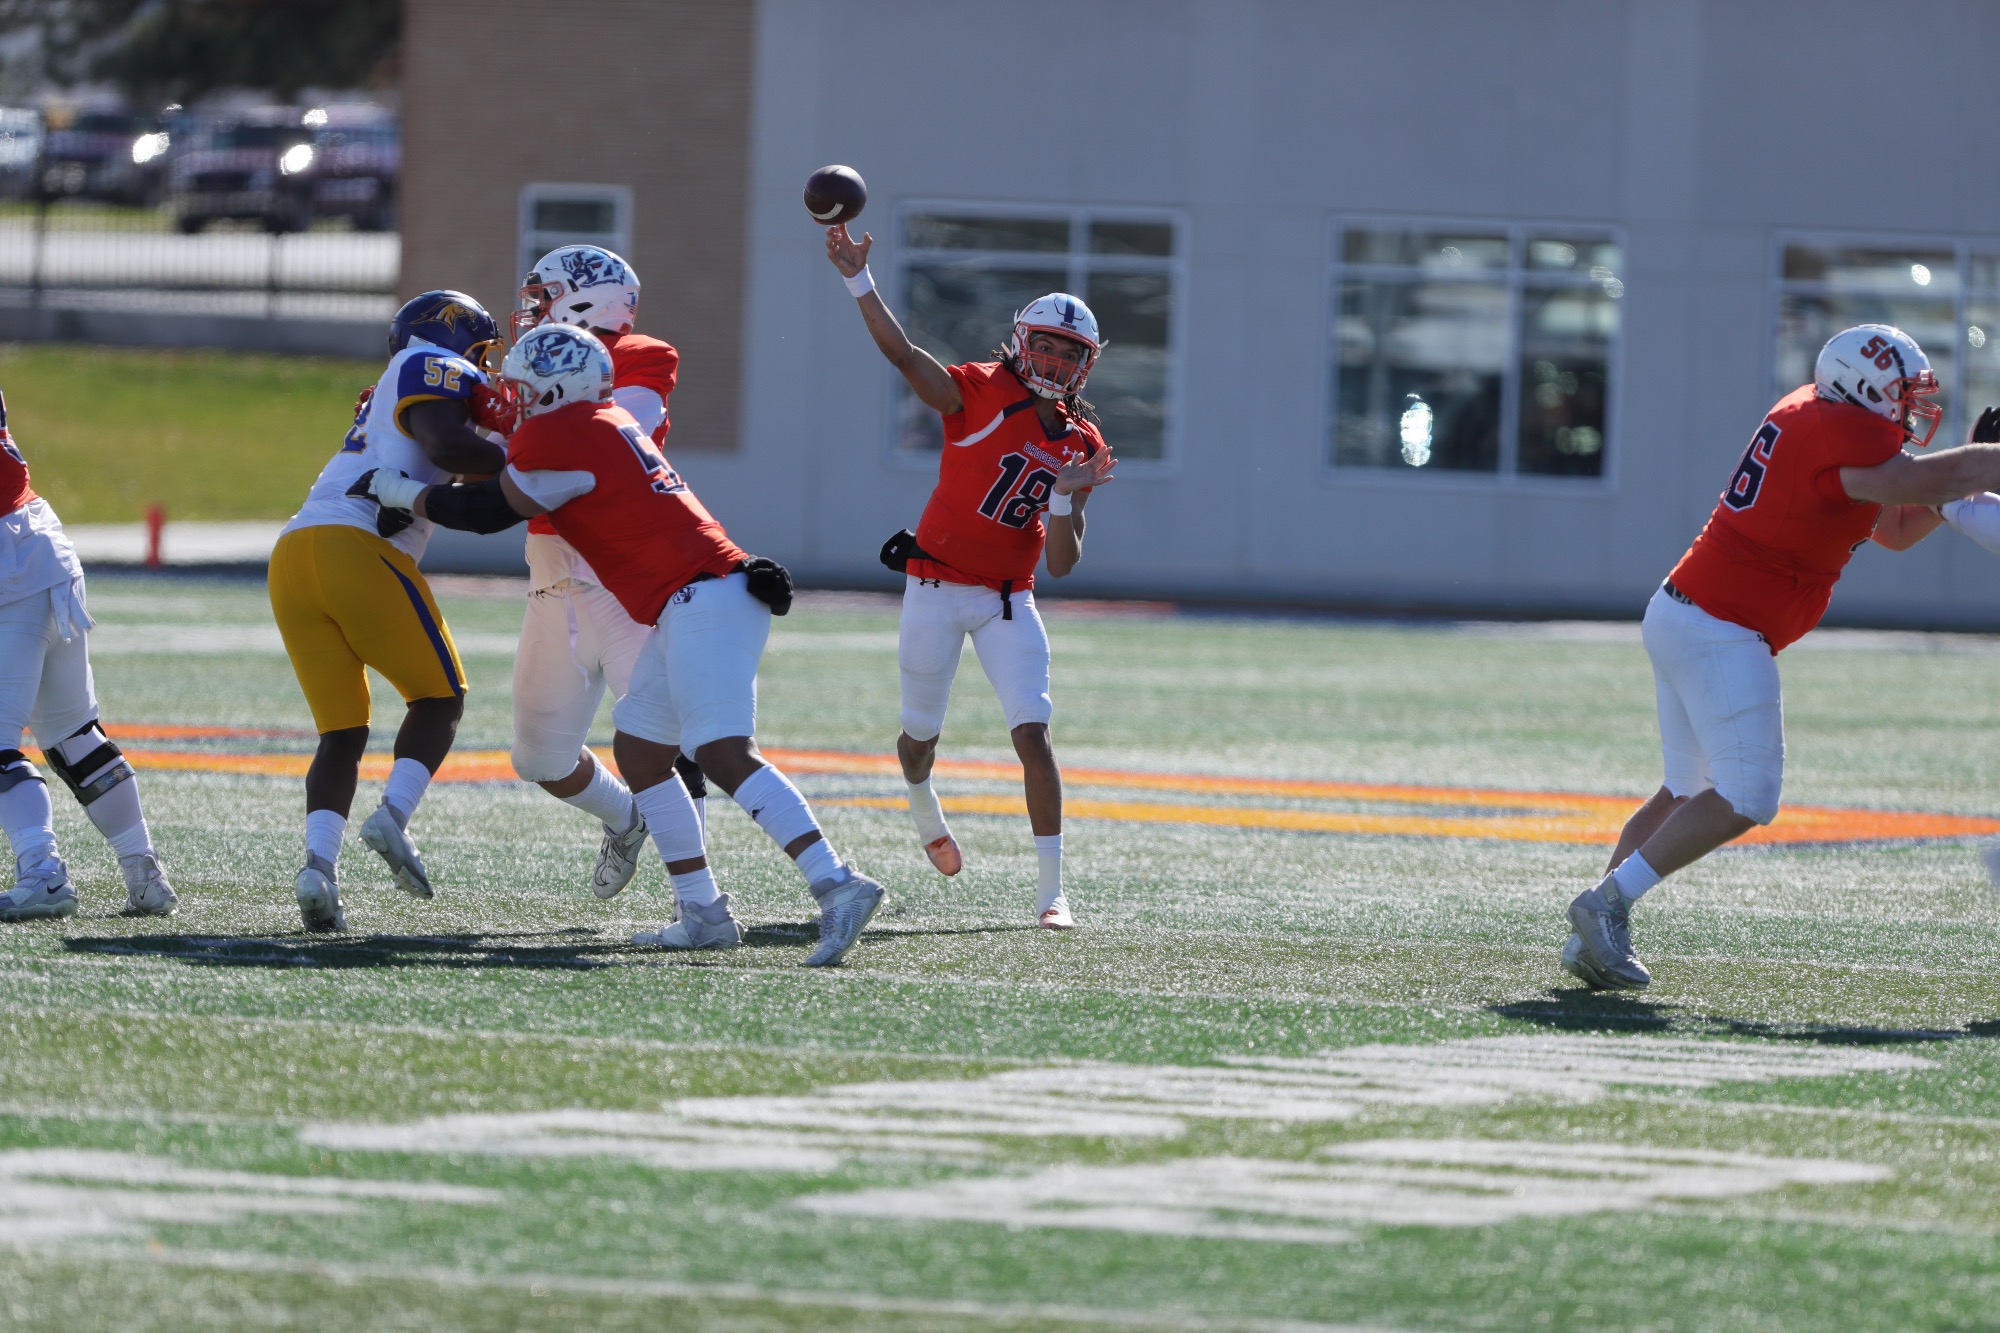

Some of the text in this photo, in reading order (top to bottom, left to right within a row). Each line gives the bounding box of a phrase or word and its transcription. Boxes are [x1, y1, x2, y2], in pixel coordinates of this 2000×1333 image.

[1860, 334, 1894, 371] 56
[423, 356, 463, 392] 52
[977, 451, 1058, 529] 18
